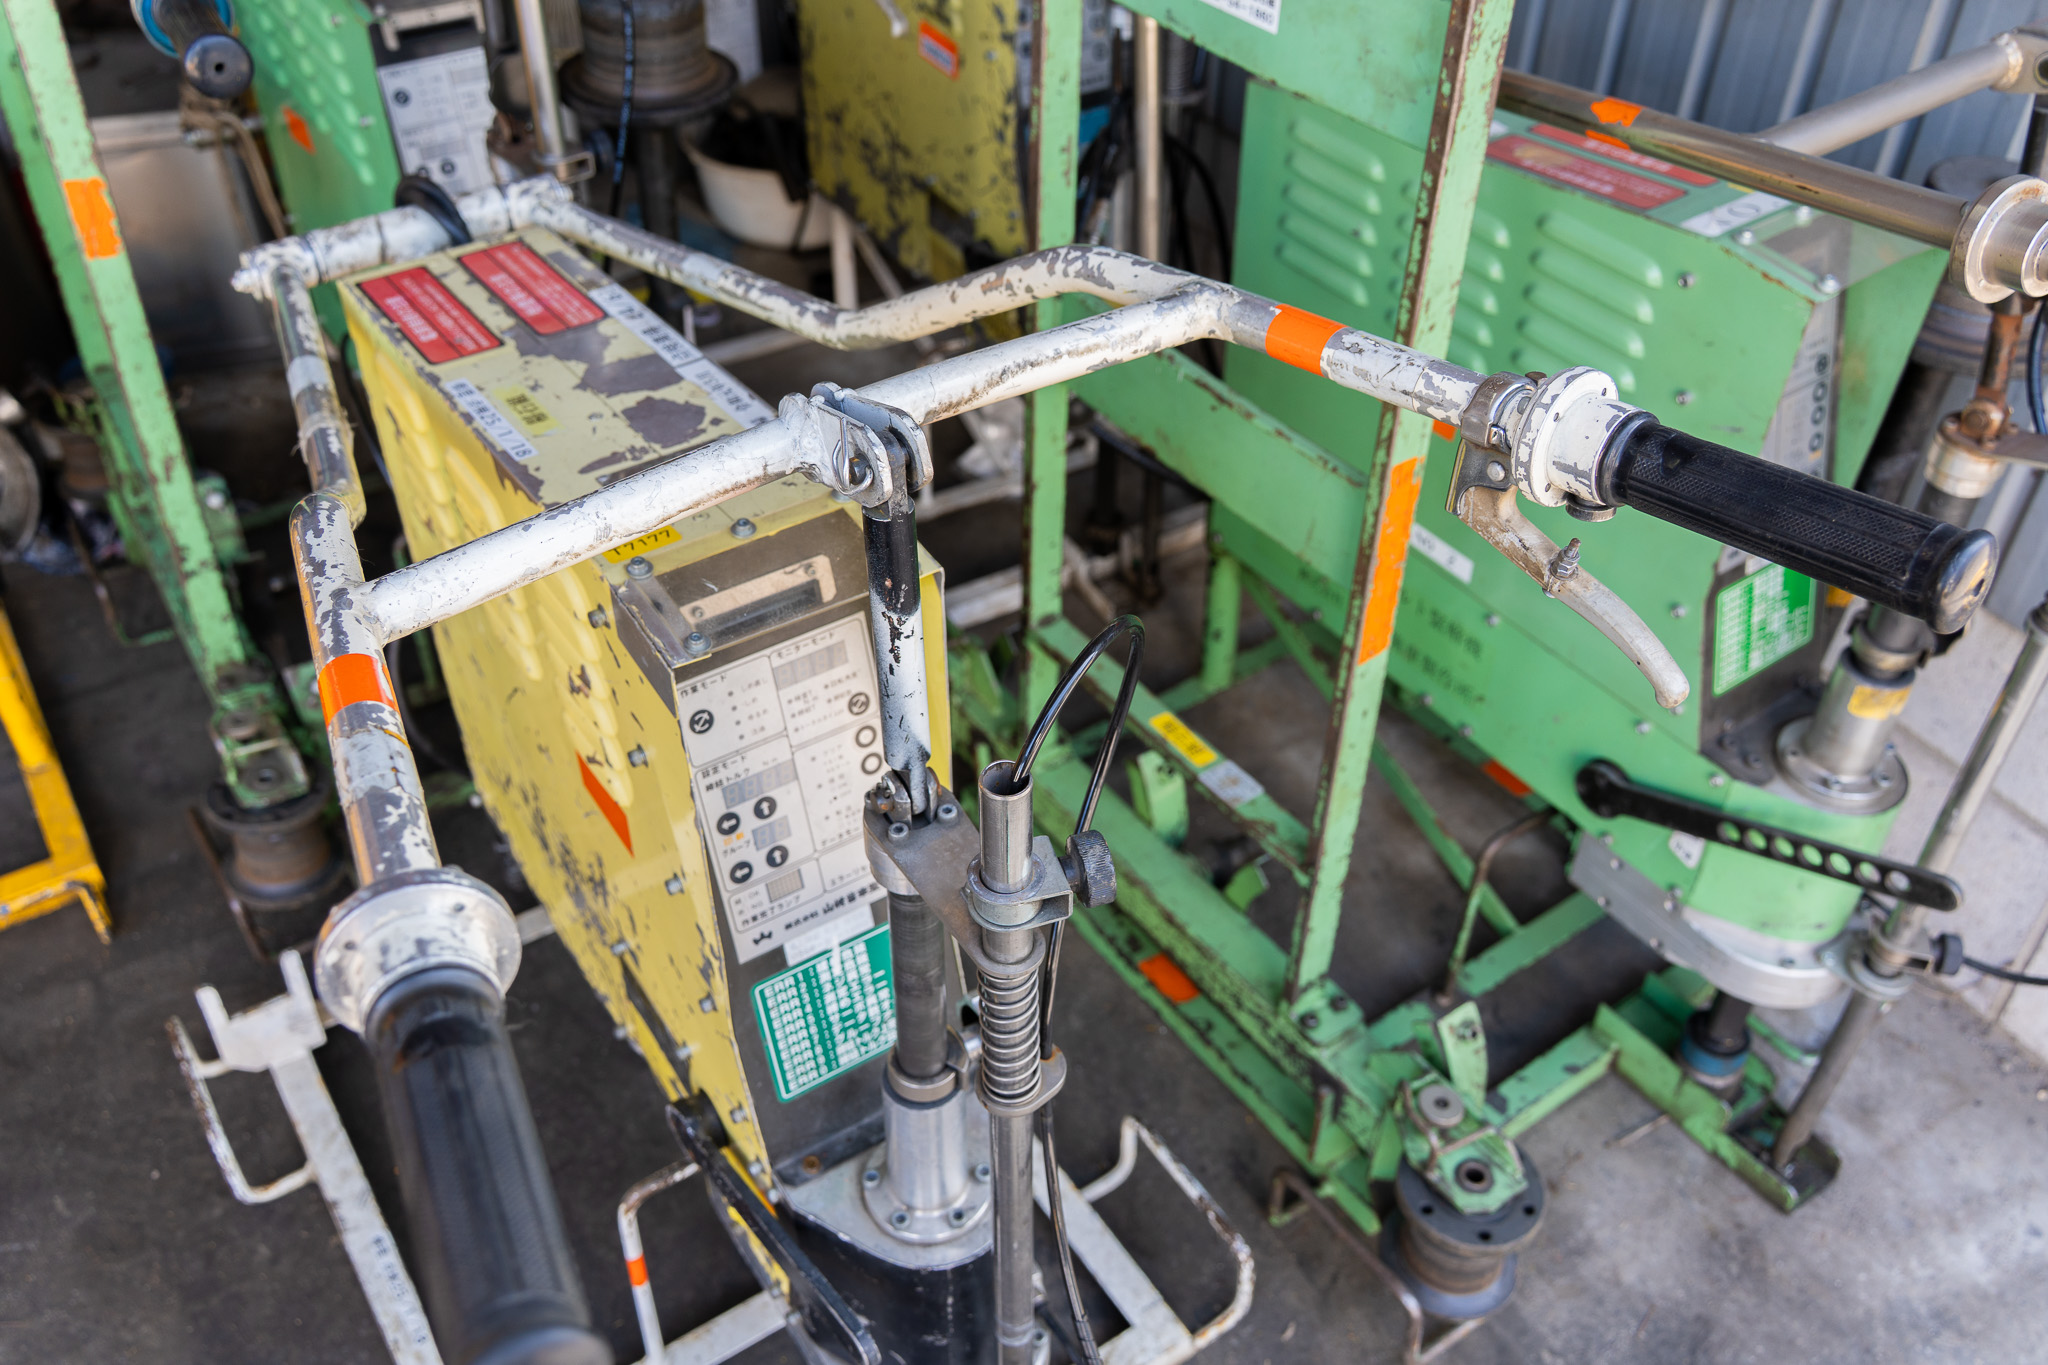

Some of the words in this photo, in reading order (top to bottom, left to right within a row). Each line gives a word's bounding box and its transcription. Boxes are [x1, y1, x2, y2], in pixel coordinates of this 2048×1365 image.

[679, 674, 727, 697] 作業モード
